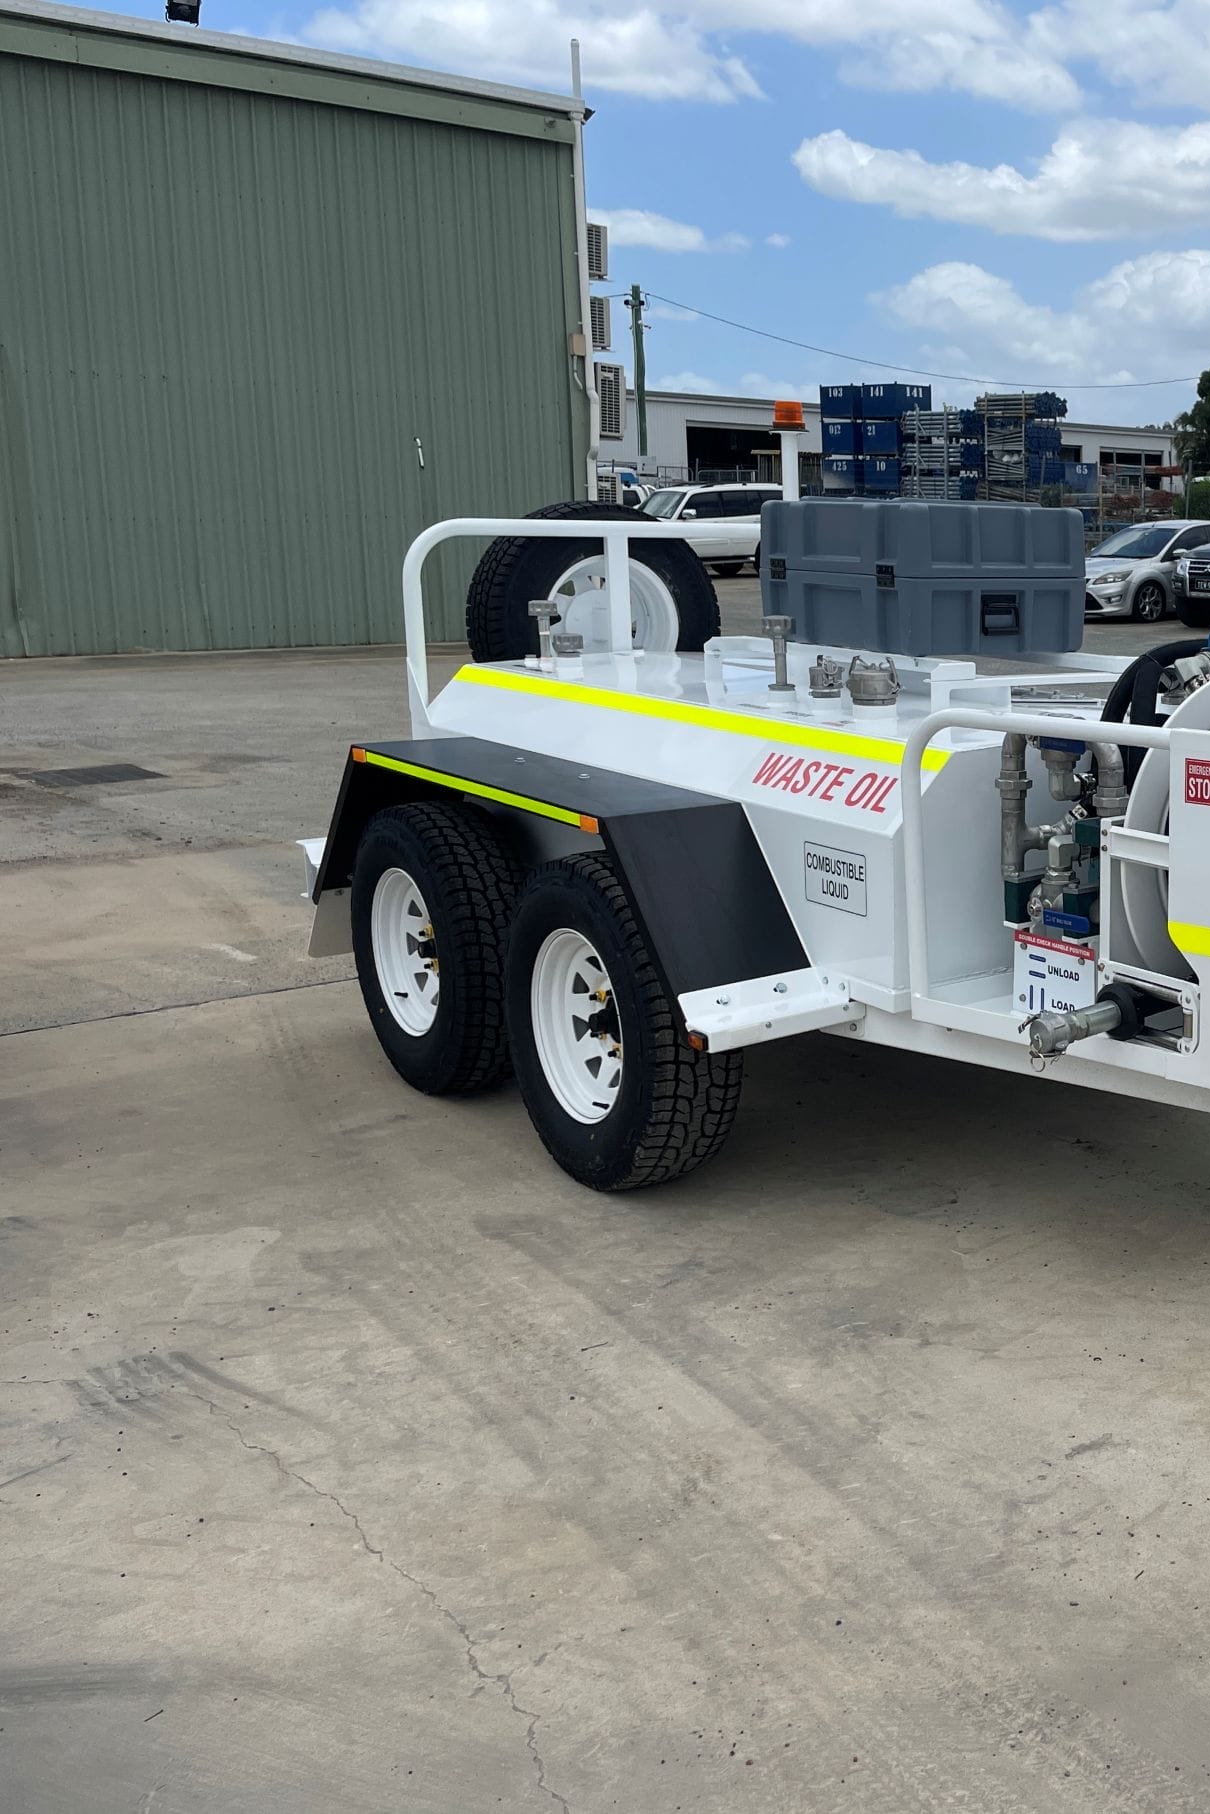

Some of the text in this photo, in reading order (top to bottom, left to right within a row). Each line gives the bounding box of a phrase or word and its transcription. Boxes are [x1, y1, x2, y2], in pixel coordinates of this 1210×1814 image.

[870, 385, 884, 397] 141
[906, 386, 923, 398] 141
[876, 461, 886, 471] 10
[1076, 464, 1088, 475] 65
[752, 752, 898, 813] WASTE OIL
[806, 852, 865, 882] COMBUSTIBLE
[821, 878, 849, 900] LIQUID
[1018, 933, 1037, 943] DOUBLE
[1036, 938, 1051, 947] CHECK
[1047, 964, 1080, 982] UNLOAD
[1051, 998, 1076, 1013] LOAD
